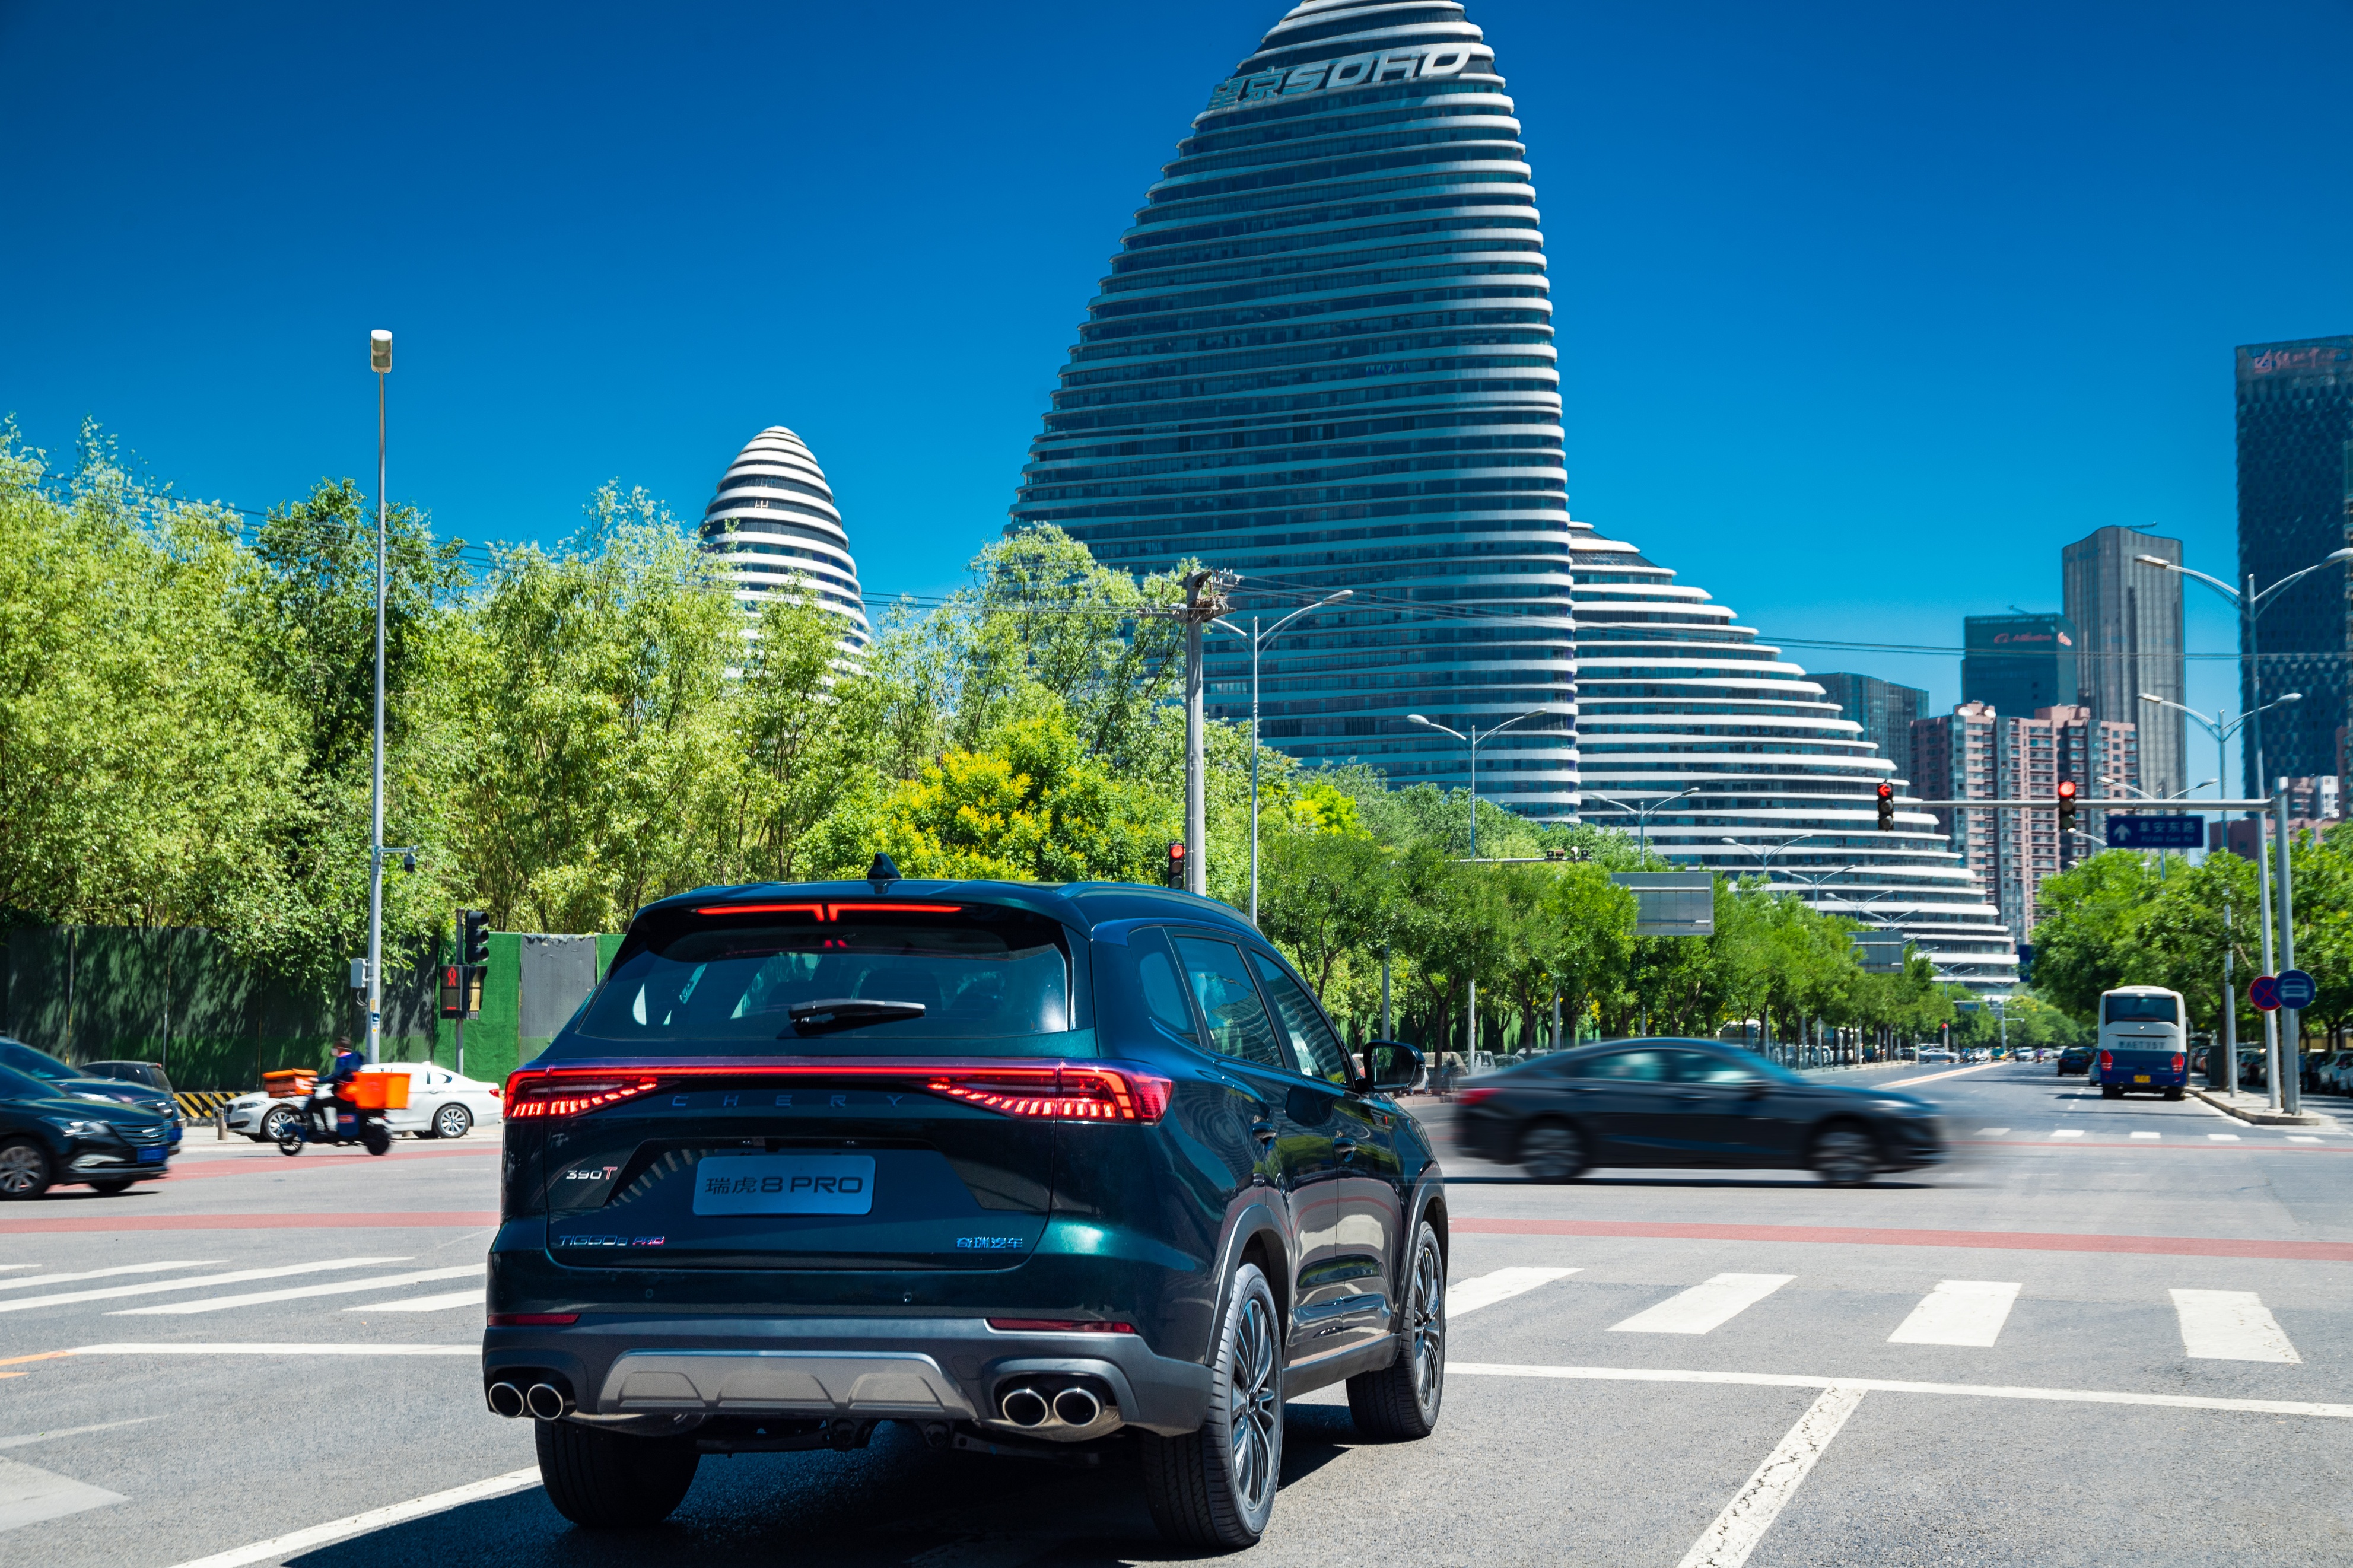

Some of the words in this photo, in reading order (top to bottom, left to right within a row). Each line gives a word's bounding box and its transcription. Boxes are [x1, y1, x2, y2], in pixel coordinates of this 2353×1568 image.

[672, 1095, 904, 1108] CHERY
[565, 1166, 618, 1181] 390T
[704, 1176, 784, 1195] 瑞虎8
[789, 1176, 864, 1194] PRO
[632, 1236, 666, 1246] PRO
[956, 1236, 1023, 1249] 奇瑞汽车
